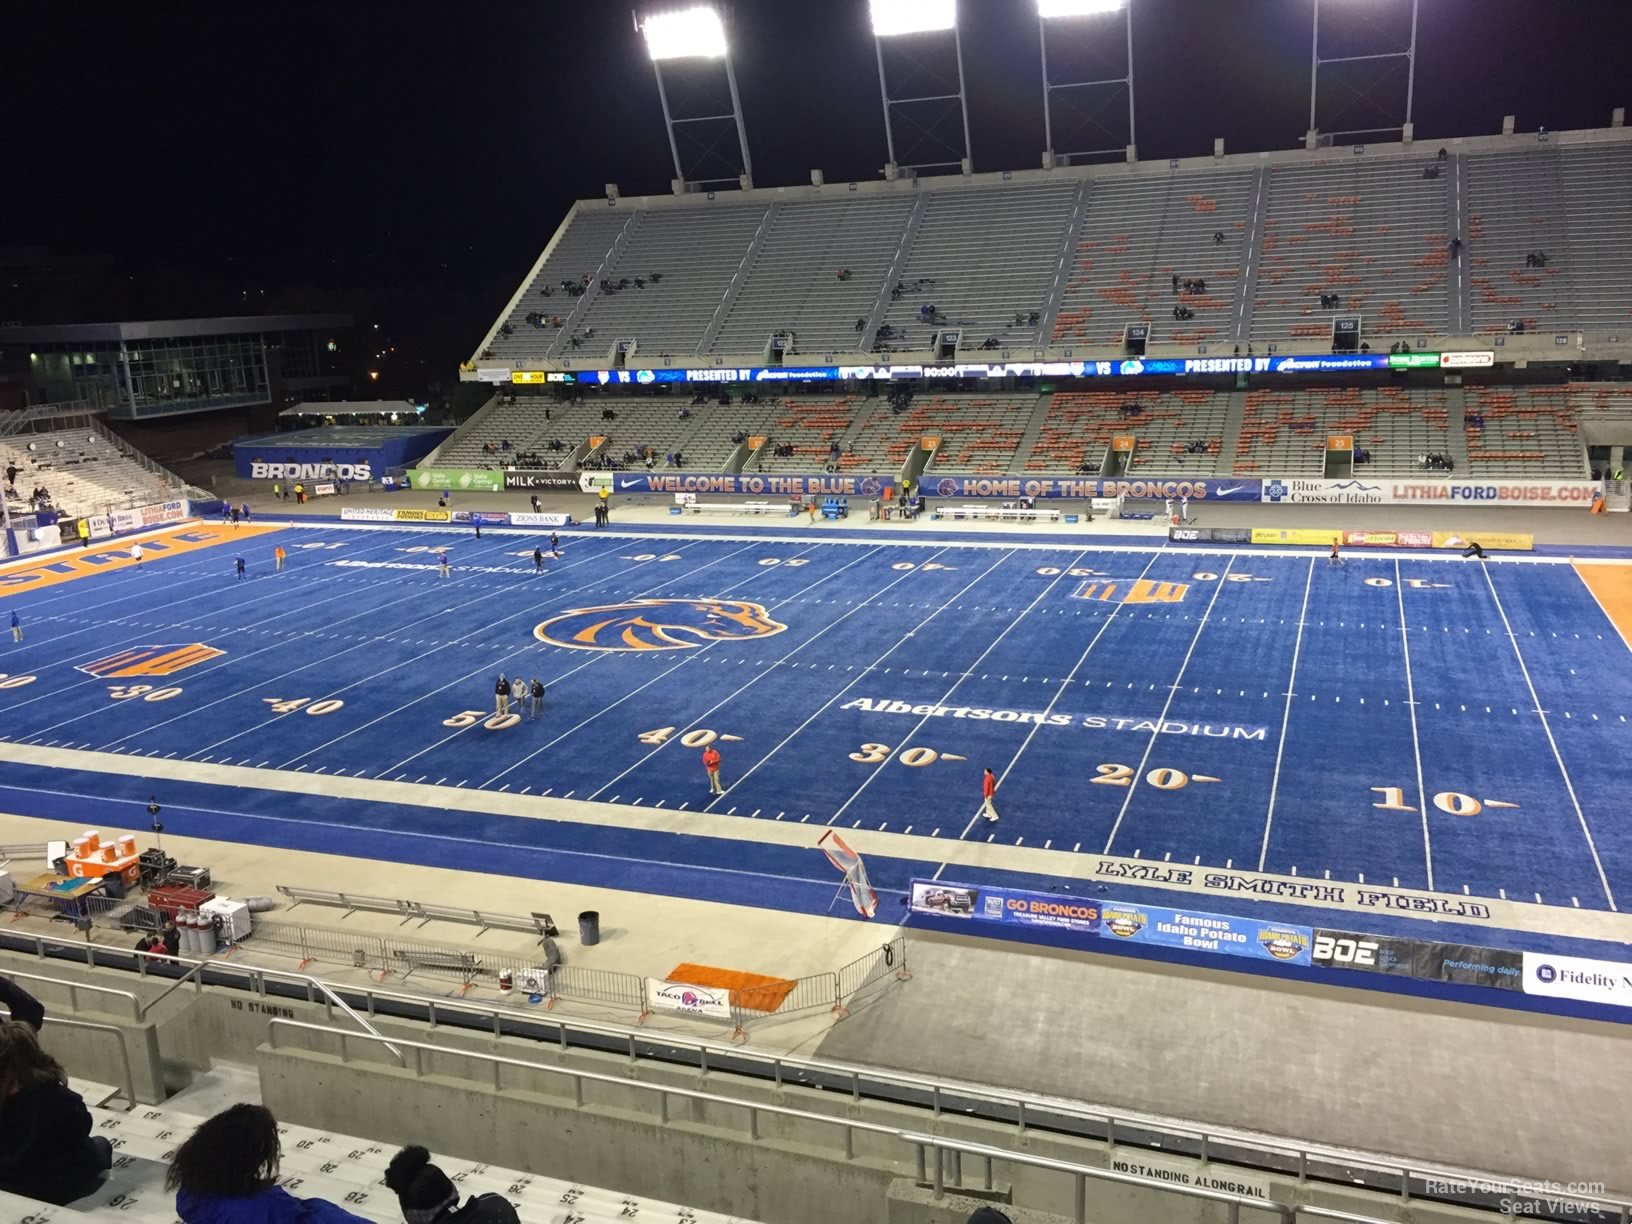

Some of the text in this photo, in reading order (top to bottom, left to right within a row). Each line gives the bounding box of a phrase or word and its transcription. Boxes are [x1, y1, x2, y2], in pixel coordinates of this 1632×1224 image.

[1096, 362, 1111, 375] VS
[1185, 358, 1272, 372] PRESENTED BY
[617, 370, 630, 383] VS
[686, 370, 750, 382] PRESENTED BY
[250, 462, 371, 480] BRONCOS
[506, 476, 534, 486] MILK
[648, 476, 855, 494] WELCOME TO THE BLUE
[964, 479, 1207, 498] HOME OF THE BRONCOS
[1292, 480, 1322, 492] Blue
[1291, 493, 1382, 504] Cross of Idaho
[1392, 484, 1597, 501] LITHIAFORDBOISE.COM
[1174, 530, 1199, 540] BOE
[443, 710, 522, 730] 50
[840, 697, 1268, 740] Albertsons STADIUM
[637, 726, 718, 748] 40
[848, 743, 938, 767] 30
[1090, 763, 1189, 790] 20
[1370, 786, 1482, 816] 10
[72, 863, 84, 877] G
[128, 865, 136, 876] G
[1096, 860, 1491, 918] LYLE SMITH FIELD
[1006, 898, 1028, 912] GO
[1030, 901, 1098, 920] BRONCOS
[1111, 924, 1136, 932] BOWL
[1174, 913, 1230, 930] Famous
[1157, 922, 1247, 943] Idaho Potato
[1183, 936, 1218, 950] Bowl
[1270, 945, 1295, 954] BOWL
[1312, 936, 1379, 966] BOE
[1497, 966, 1522, 976] daily.
[1560, 970, 1617, 990] Fidelity
[656, 991, 724, 1006] TACO BELL
[230, 999, 294, 1018] NO STANDING
[1130, 1165, 1190, 1184] STANDING
